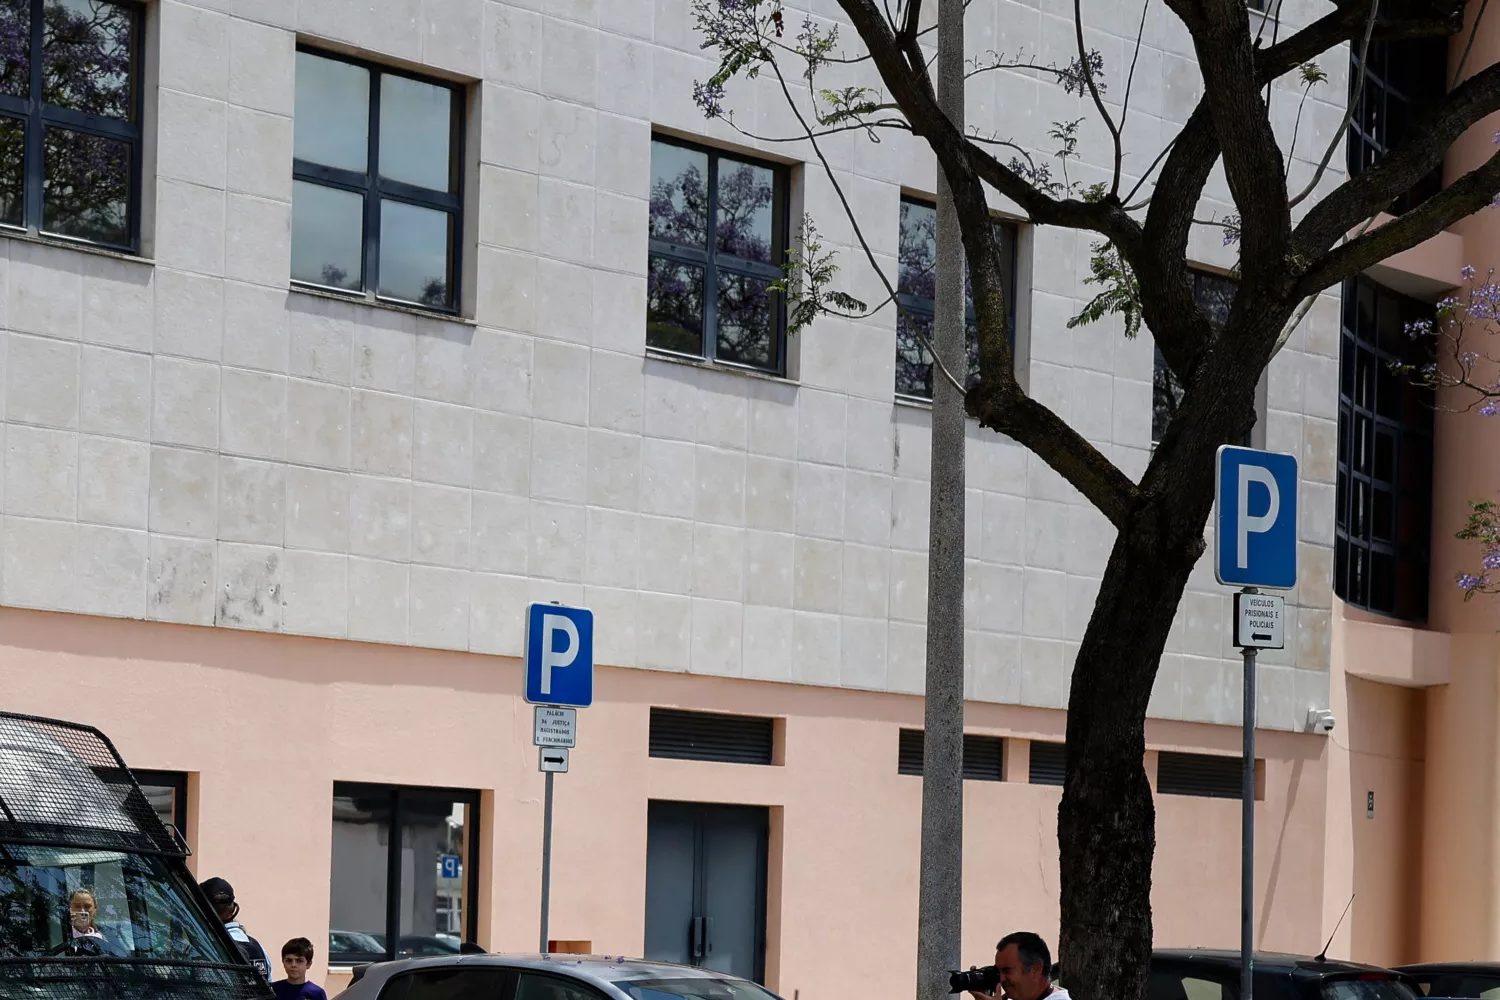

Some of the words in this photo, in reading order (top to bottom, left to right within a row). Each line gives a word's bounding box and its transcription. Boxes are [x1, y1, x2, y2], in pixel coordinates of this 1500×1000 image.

[1237, 464, 1280, 568] P
[1250, 598, 1274, 607] VEÍCULOS
[1244, 609, 1273, 618] PRISIONAIS
[1249, 620, 1274, 628] POLICIAIS
[541, 613, 580, 694] P
